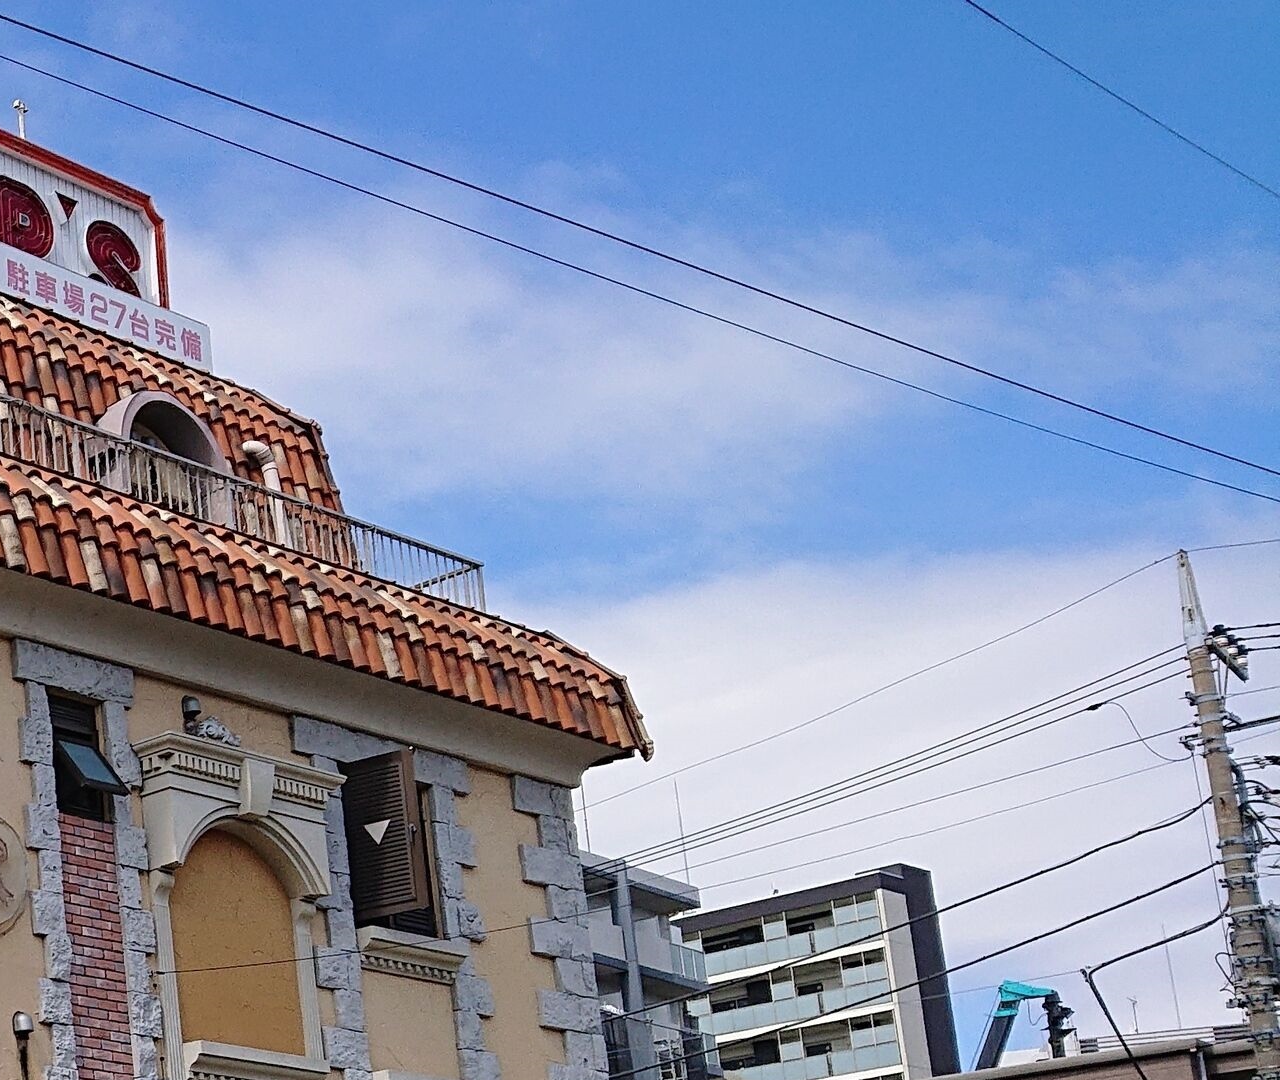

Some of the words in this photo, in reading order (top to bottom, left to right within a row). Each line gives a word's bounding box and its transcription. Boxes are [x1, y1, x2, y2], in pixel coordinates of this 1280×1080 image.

[6, 258, 203, 362] 駐車場27台完備
